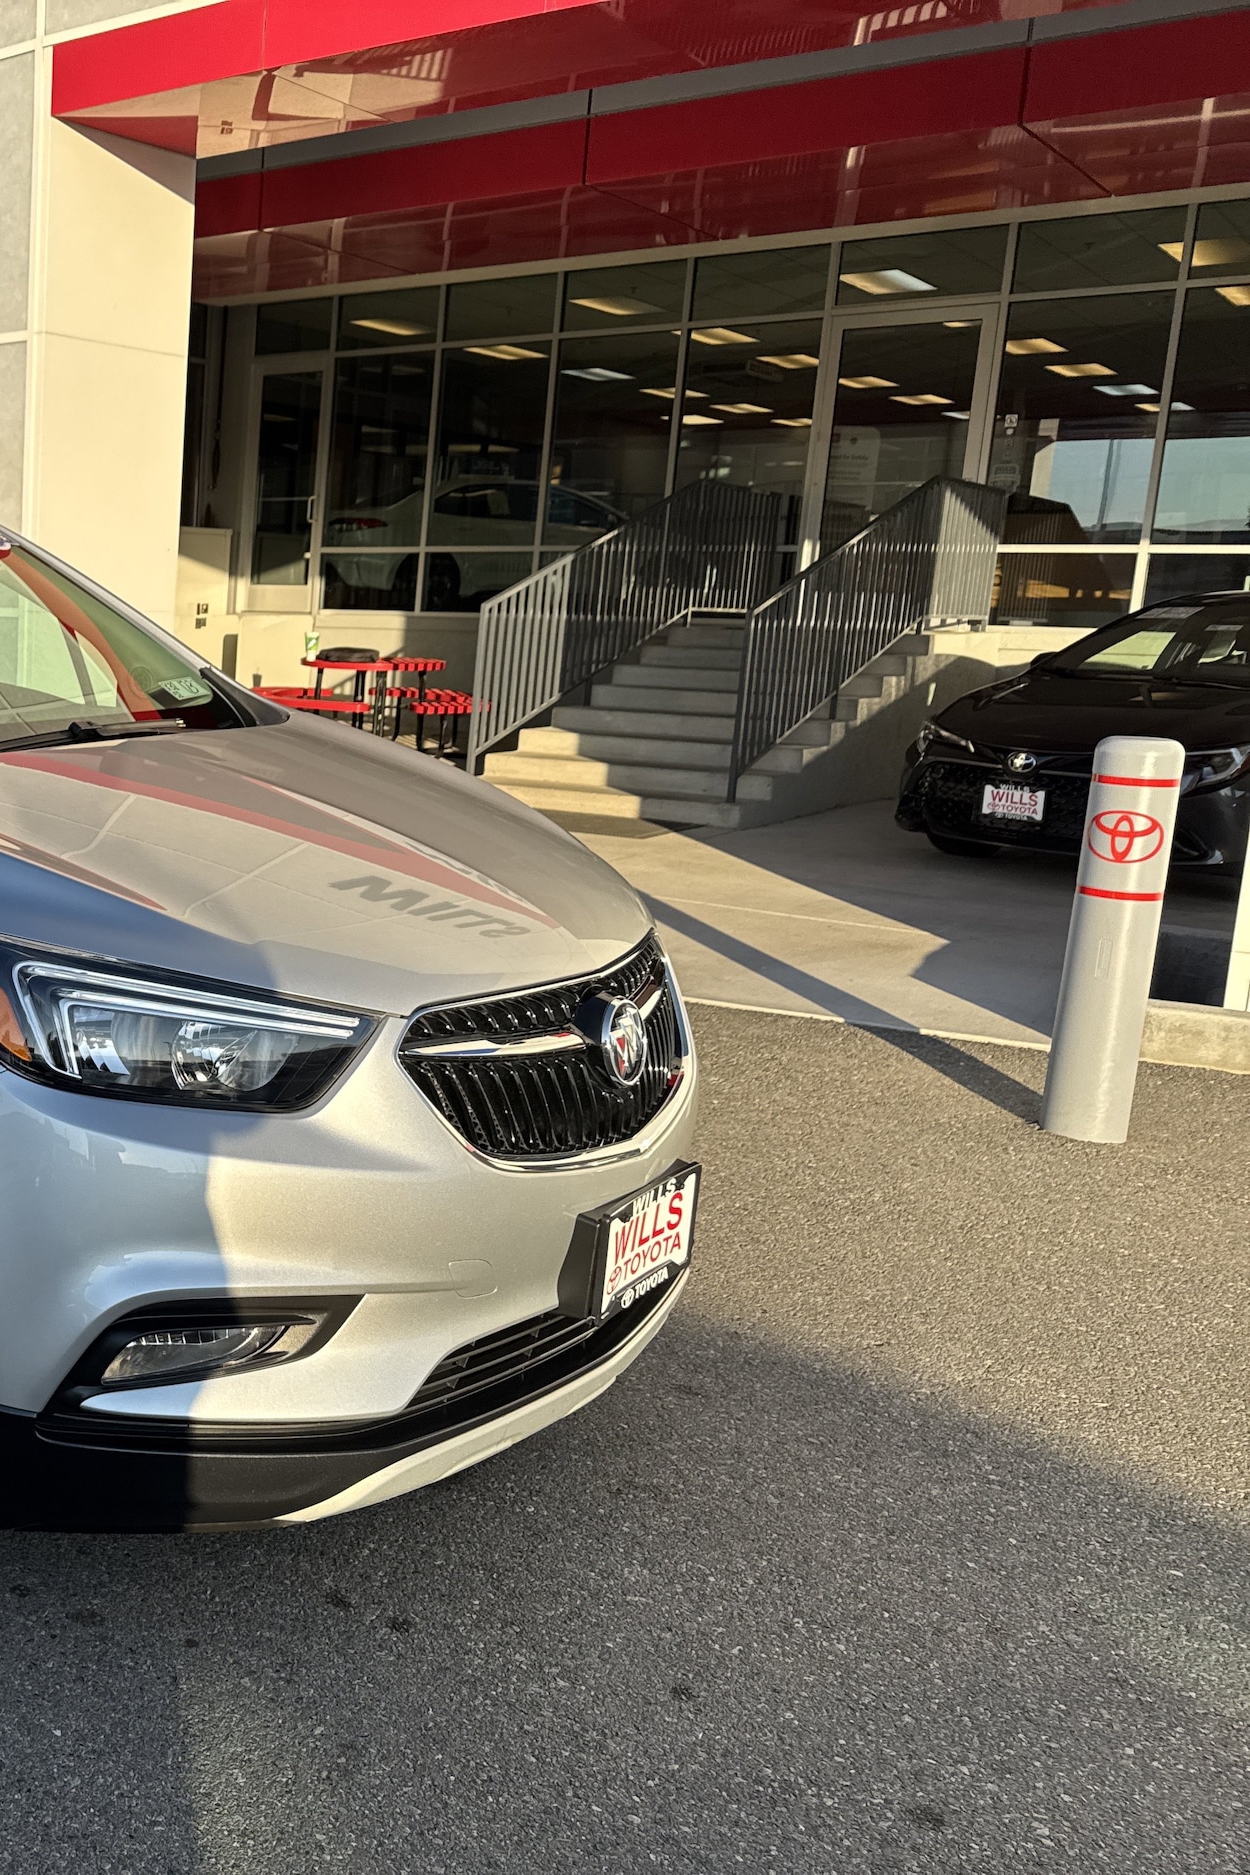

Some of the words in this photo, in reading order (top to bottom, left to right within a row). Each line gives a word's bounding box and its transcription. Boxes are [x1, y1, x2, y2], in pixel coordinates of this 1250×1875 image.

[991, 790, 1038, 807] WILLS
[1000, 783, 1030, 792] WILLS
[1002, 804, 1038, 815] TOYOTA
[632, 1177, 677, 1214] WILLS
[615, 1192, 683, 1265] WILLS
[623, 1232, 681, 1280] TOYOTA
[635, 1267, 669, 1298] TOYOTA
